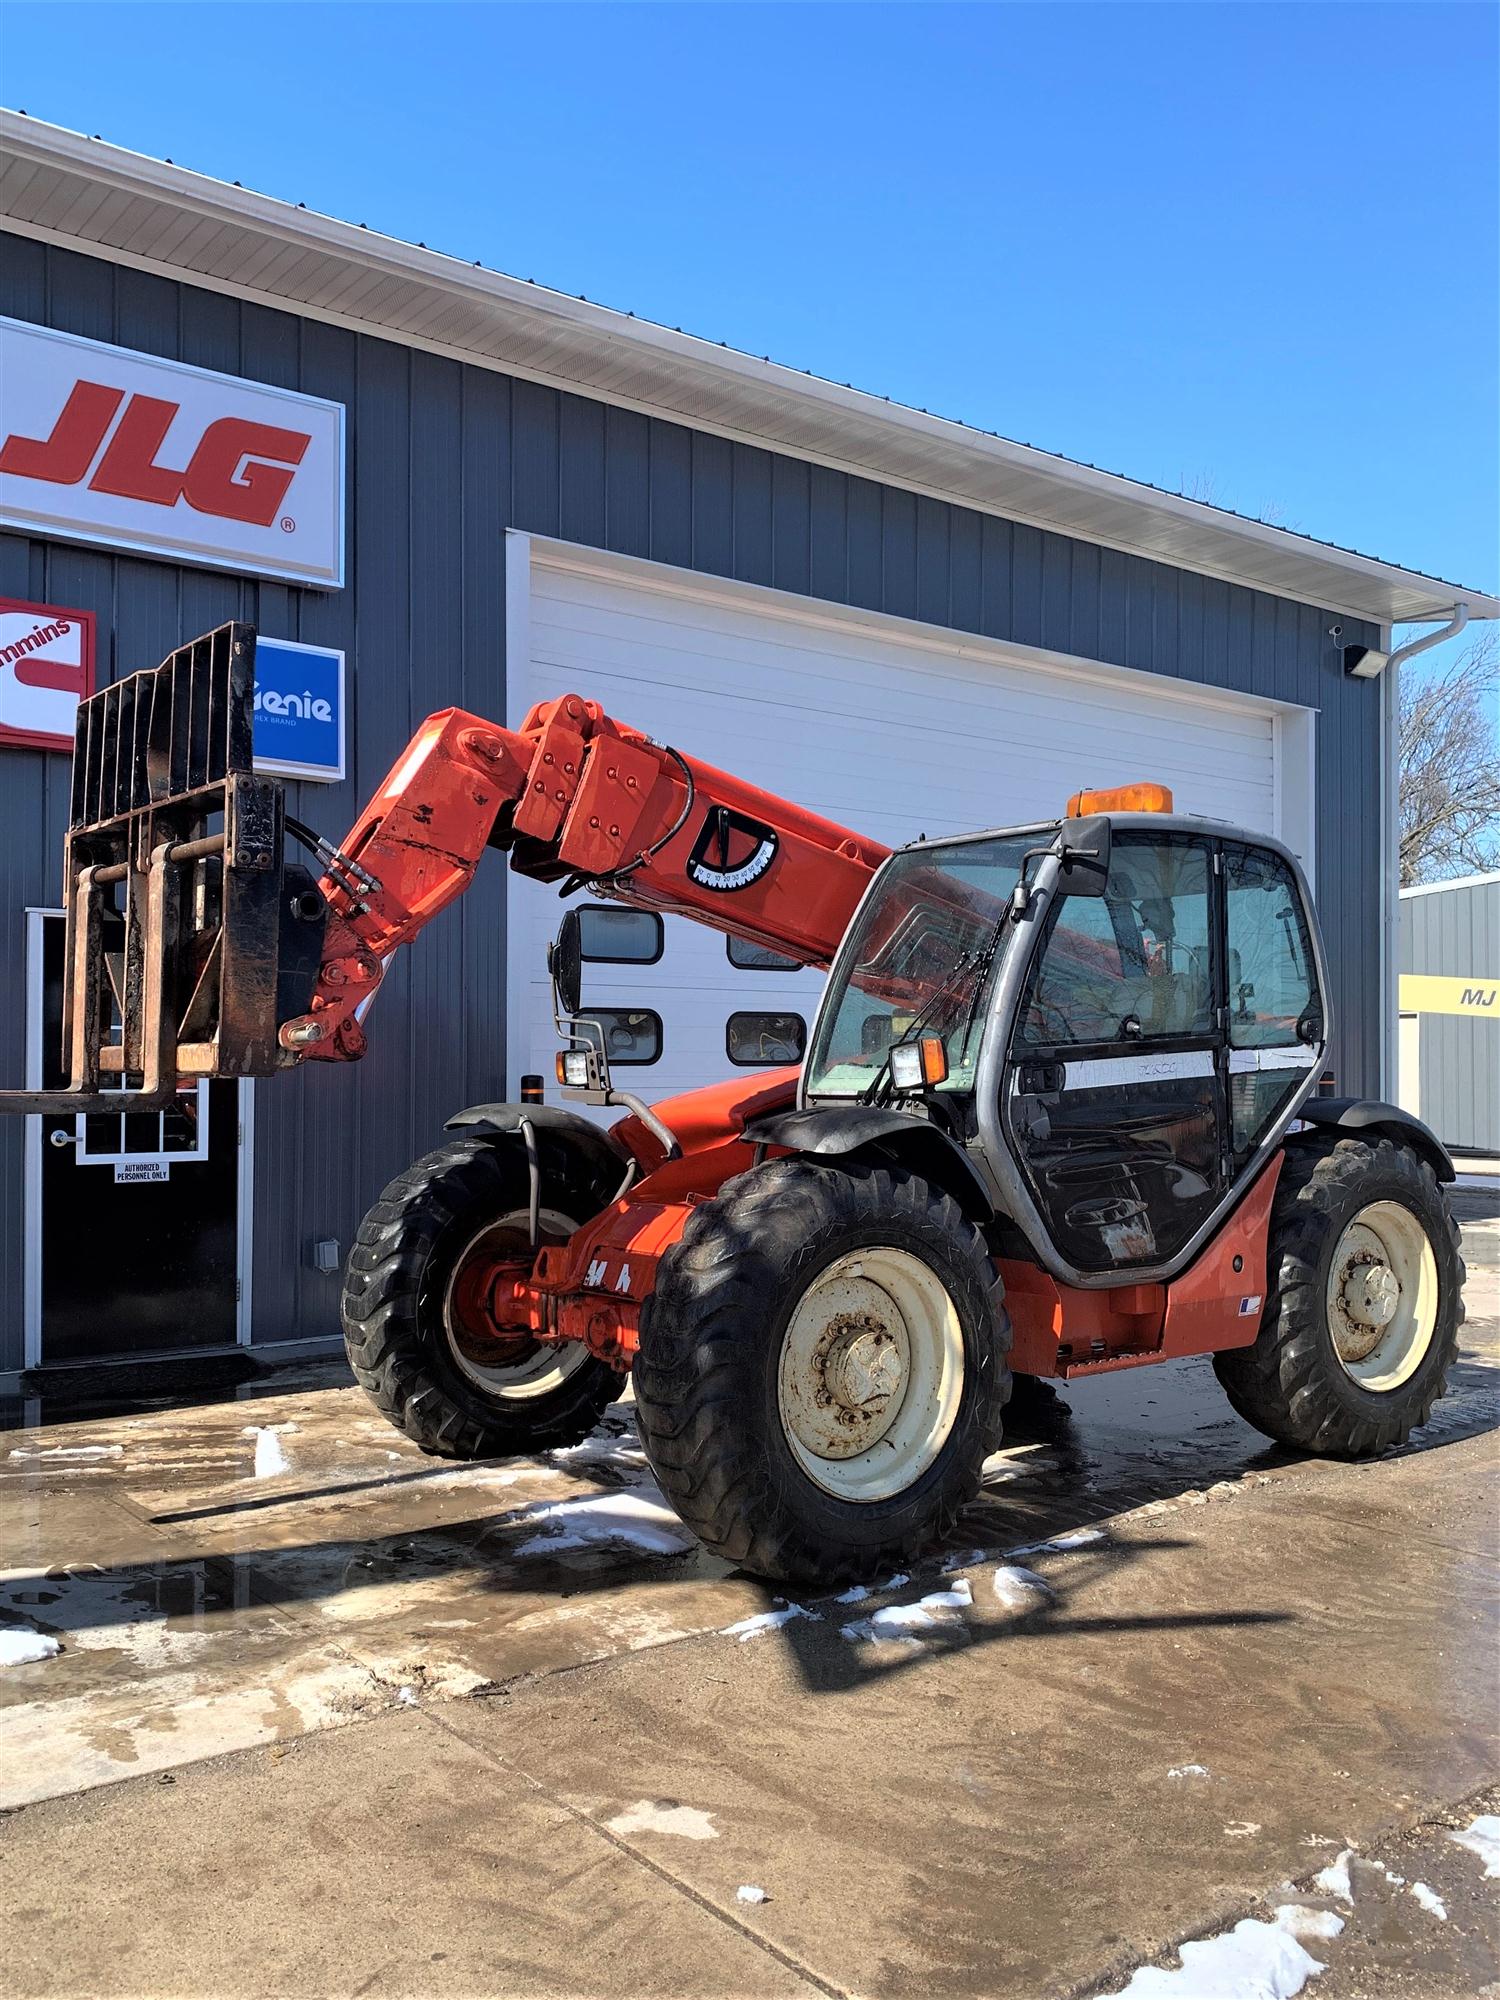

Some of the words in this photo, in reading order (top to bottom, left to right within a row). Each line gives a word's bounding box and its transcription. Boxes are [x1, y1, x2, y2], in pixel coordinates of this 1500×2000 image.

[0, 379, 312, 527] JLG
[270, 717, 297, 727] BRAND
[741, 870, 748, 878] 40
[748, 865, 755, 873] 50
[1460, 988, 1497, 1006] MJ
[124, 1163, 160, 1172] AUTHORIZED
[117, 1171, 151, 1181] PERSONNEL
[151, 1171, 167, 1179] ONLY
